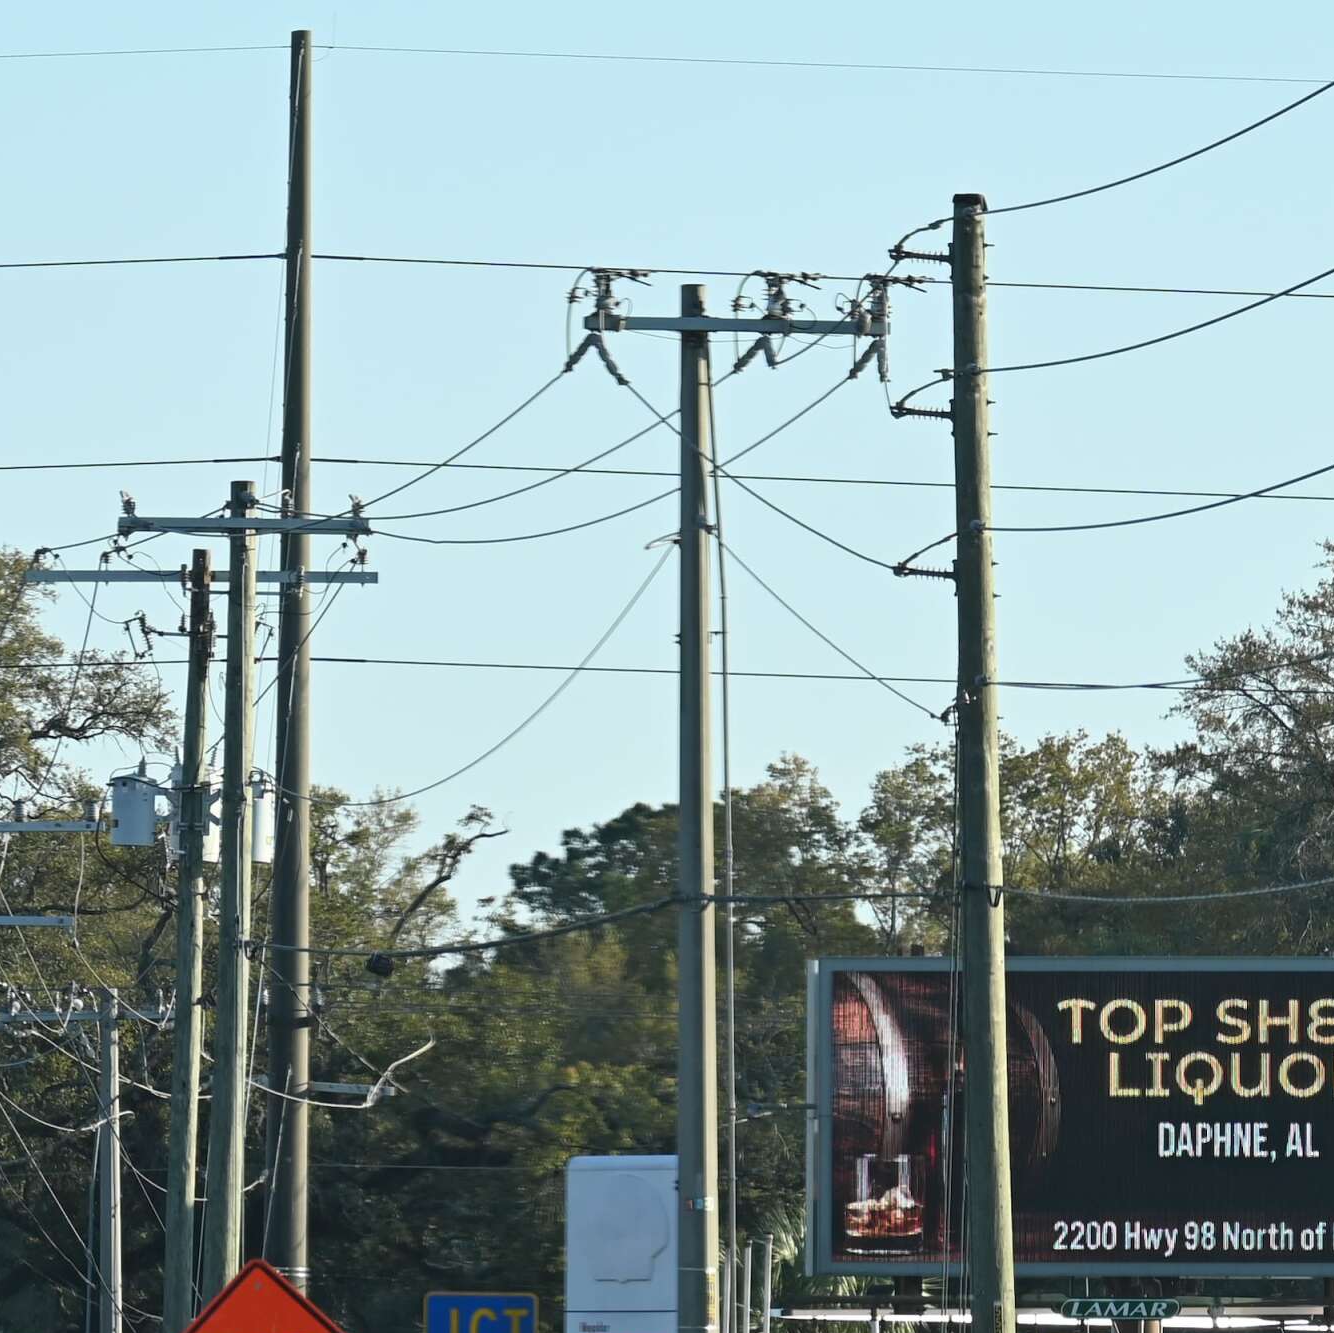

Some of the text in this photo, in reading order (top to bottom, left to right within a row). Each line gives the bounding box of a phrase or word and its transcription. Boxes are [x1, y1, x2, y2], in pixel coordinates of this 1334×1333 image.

[1057, 998, 1193, 1044] TOP
[1158, 1121, 1320, 1164] DAPHNE, AL
[1053, 1221, 1117, 1251] 2200
[1124, 1221, 1179, 1258] Hwy
[1184, 1221, 1216, 1251] 98
[1222, 1221, 1292, 1251] North
[1299, 1221, 1327, 1251] of
[1070, 1301, 1167, 1317] LAMAR
